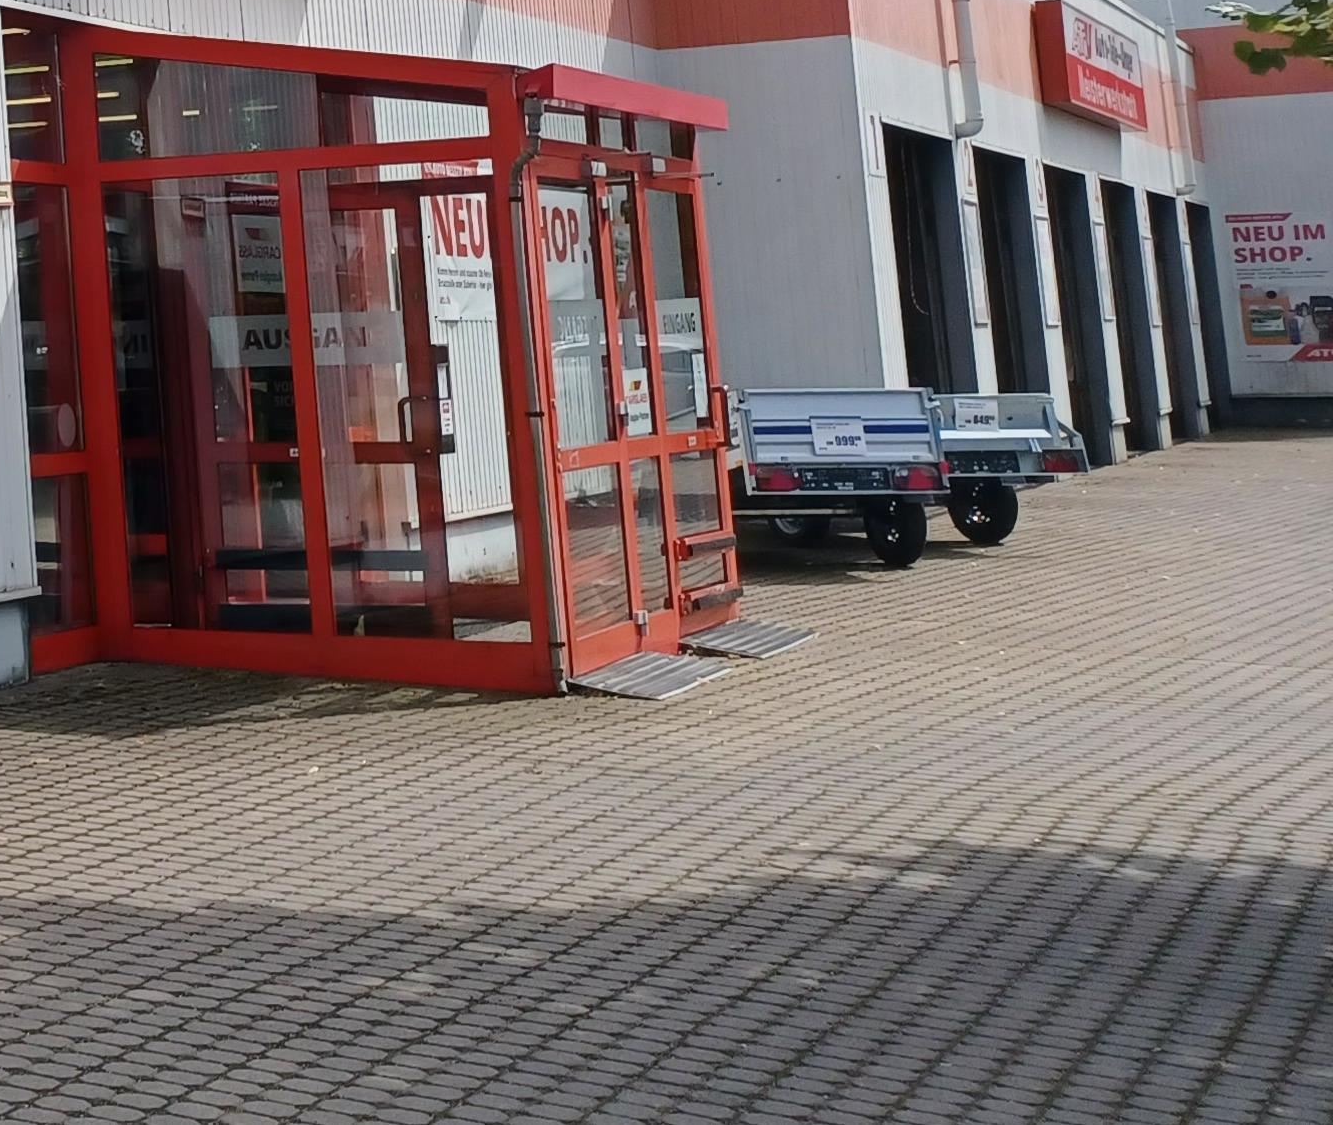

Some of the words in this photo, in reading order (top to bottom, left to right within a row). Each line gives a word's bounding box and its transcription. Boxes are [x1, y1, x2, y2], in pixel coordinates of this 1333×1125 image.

[430, 194, 485, 260] NEU
[539, 206, 589, 264] HOP.
[1232, 225, 1285, 243] NEU
[1293, 223, 1326, 241] IM
[1234, 246, 1313, 264] SHOP.
[662, 312, 696, 335] EINGANG
